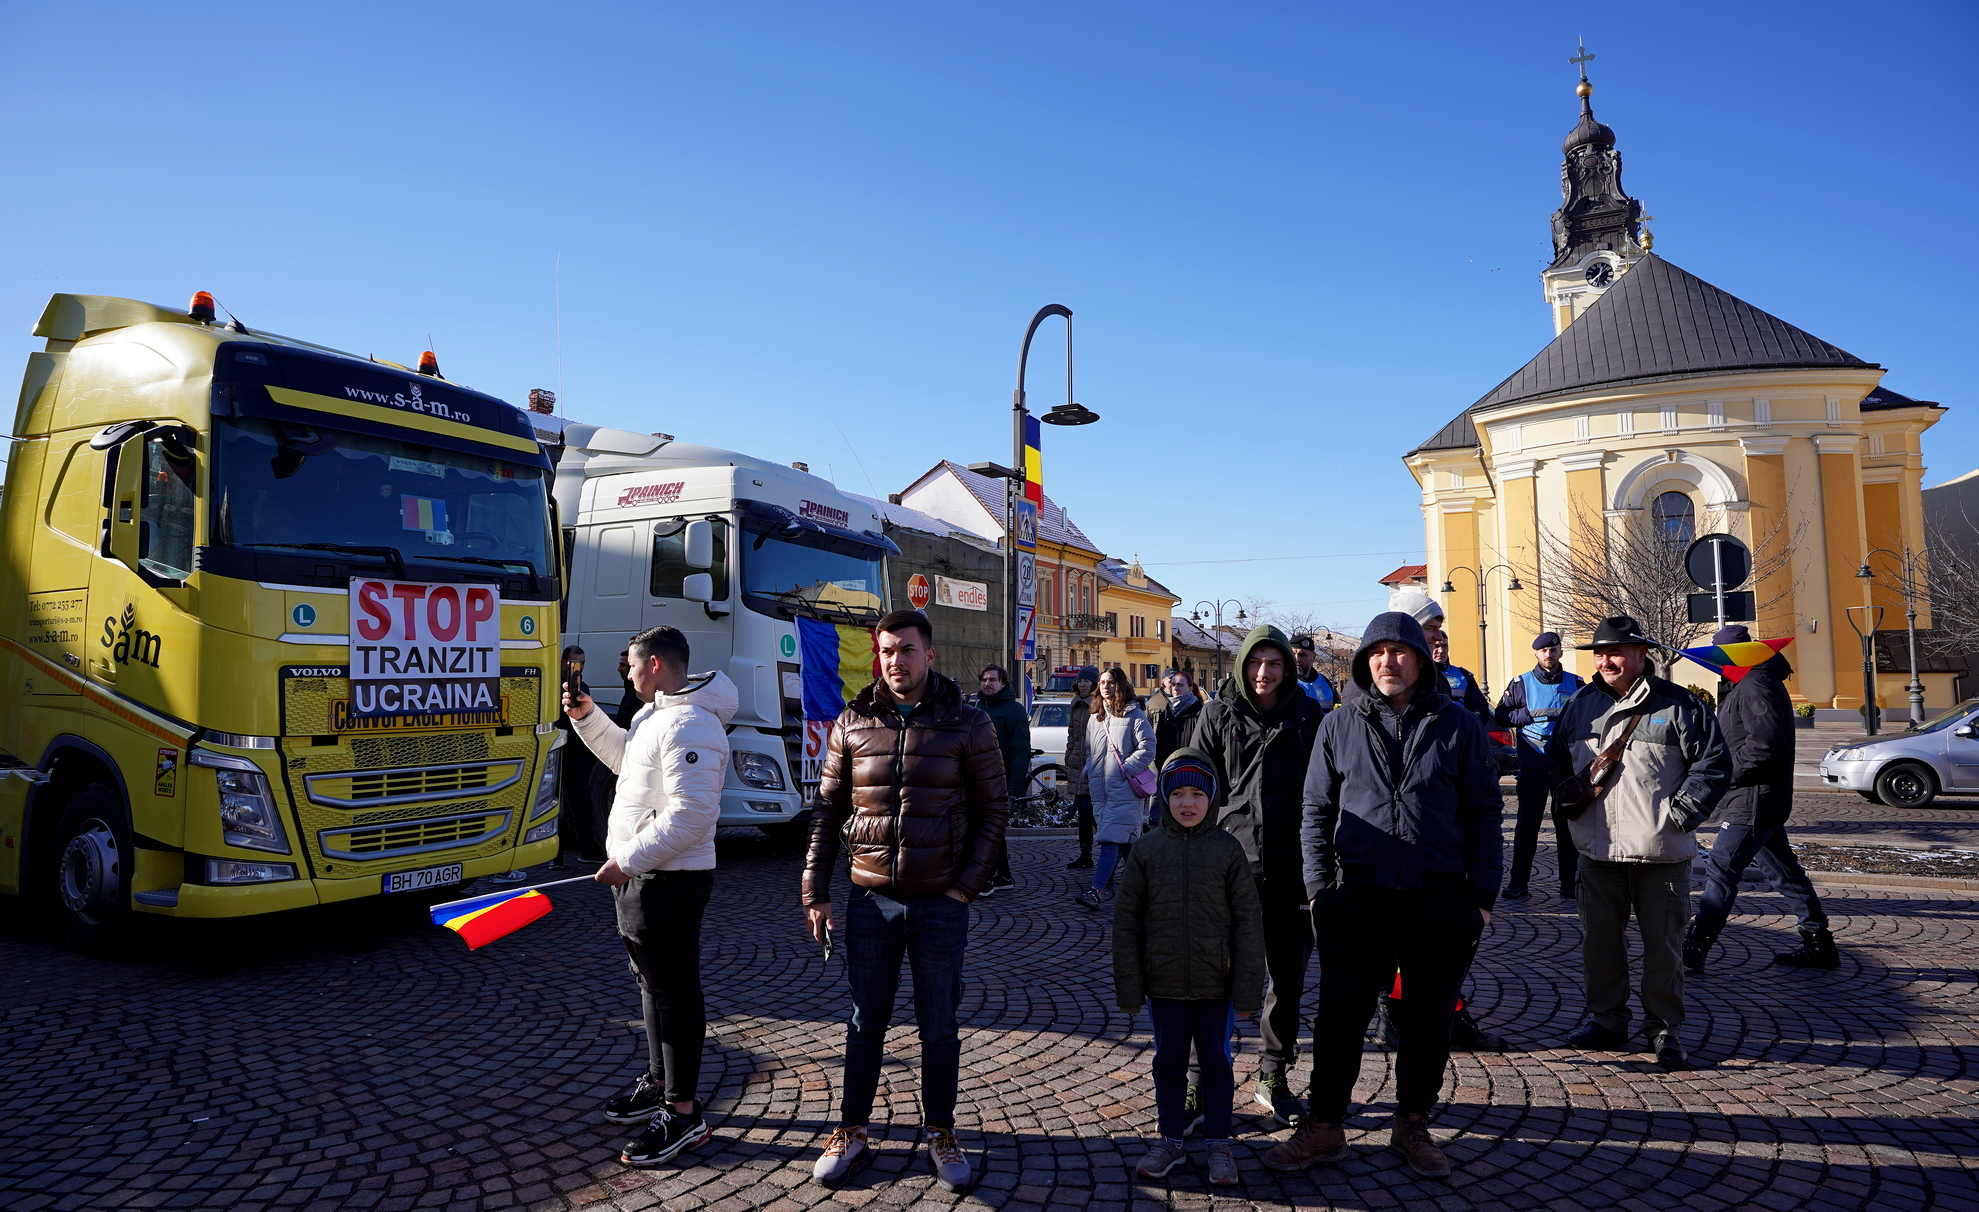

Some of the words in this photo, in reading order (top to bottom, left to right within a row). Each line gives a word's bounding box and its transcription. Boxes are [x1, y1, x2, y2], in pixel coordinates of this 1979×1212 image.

[631, 481, 685, 499] PAINICH
[809, 501, 849, 523] PAINICH
[1022, 564, 1031, 581] 20
[909, 584, 929, 599] STOP
[30, 600, 41, 612] Tel:
[42, 601, 57, 612] 0772
[57, 600, 69, 611] 255
[70, 599, 83, 610] 277
[356, 581, 494, 643] STOP
[356, 645, 494, 674] TRANZIT
[290, 668, 342, 677] VOLVO
[524, 668, 537, 676] FH
[355, 682, 494, 712] UCRAINA
[391, 873, 412, 890] BH
[417, 870, 433, 887] 70
[434, 866, 461, 884] AGR
